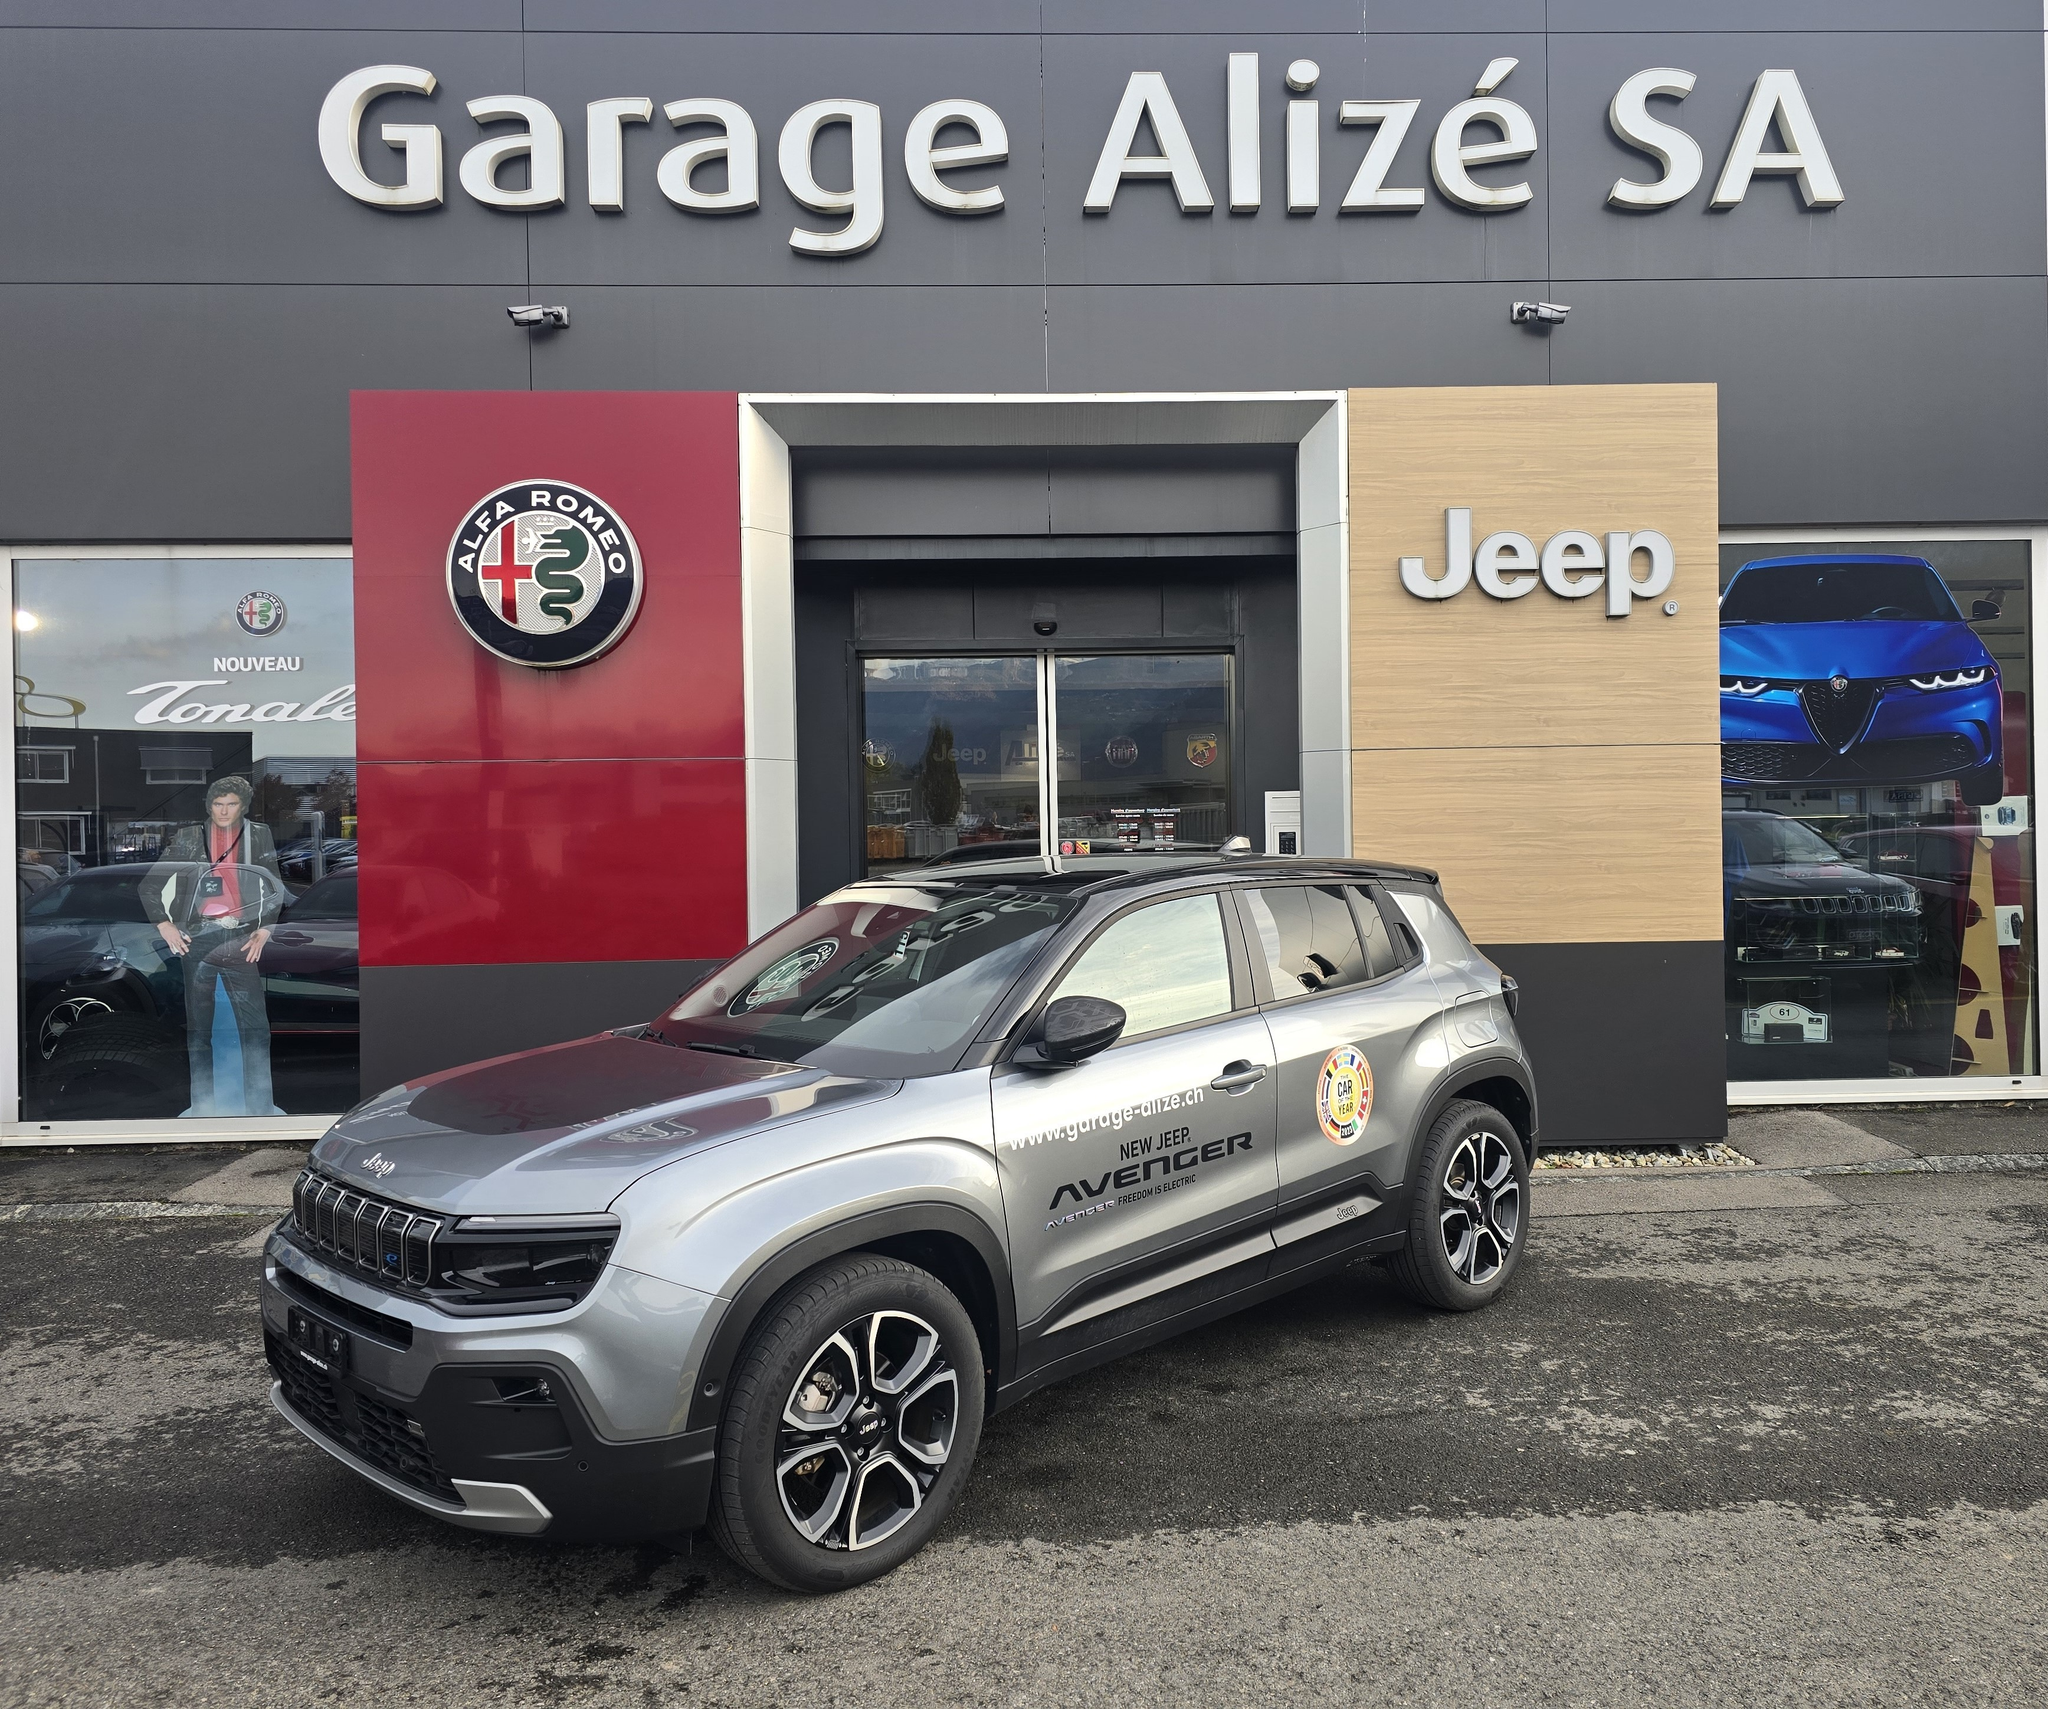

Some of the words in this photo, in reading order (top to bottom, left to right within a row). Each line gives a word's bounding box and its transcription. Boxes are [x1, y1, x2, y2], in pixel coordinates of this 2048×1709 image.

[318, 64, 1009, 256] Garage
[1083, 52, 1538, 213] Alizé
[1607, 67, 1846, 210] SA
[458, 501, 515, 574] ALFA
[530, 490, 627, 574] ROMEO
[1398, 506, 1676, 617] Jeep
[237, 594, 253, 614] ALFA
[256, 592, 282, 614] ROMEO
[213, 656, 301, 672] NOUVEAU
[932, 743, 987, 765] Jeep
[1779, 1008, 1790, 1017] 61
[1337, 1079, 1353, 1098] CAR
[1337, 1101, 1354, 1116] YEAR
[1119, 1136, 1153, 1161] NEW
[1156, 1126, 1191, 1151] JEEP
[360, 1152, 396, 1180] Jeep
[1049, 1131, 1254, 1211] AVENGER
[1117, 1187, 1153, 1207] FREEDOM
[1154, 1183, 1162, 1195] IS
[1163, 1174, 1197, 1193] ELECTRIC
[1044, 1200, 1115, 1231] AVENGER
[1336, 1204, 1358, 1220] Jeep
[859, 1419, 879, 1435] Jeep
